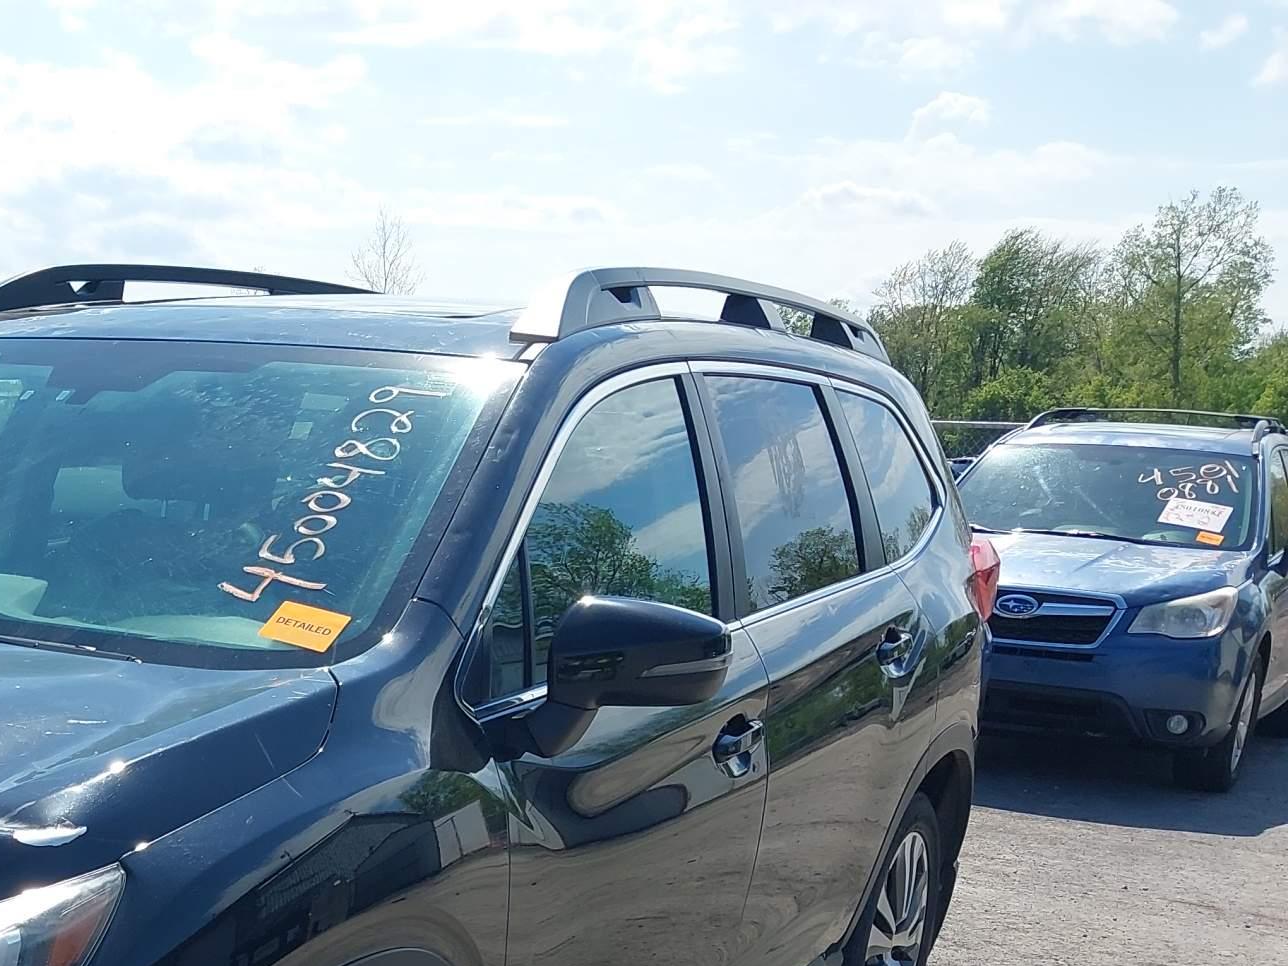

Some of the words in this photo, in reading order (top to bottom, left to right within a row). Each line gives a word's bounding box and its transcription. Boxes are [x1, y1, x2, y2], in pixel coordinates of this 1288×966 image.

[1138, 460, 1240, 486] 4501
[216, 385, 446, 602] 45004829
[1156, 474, 1240, 501] 0881
[275, 615, 333, 637] DETAILED
